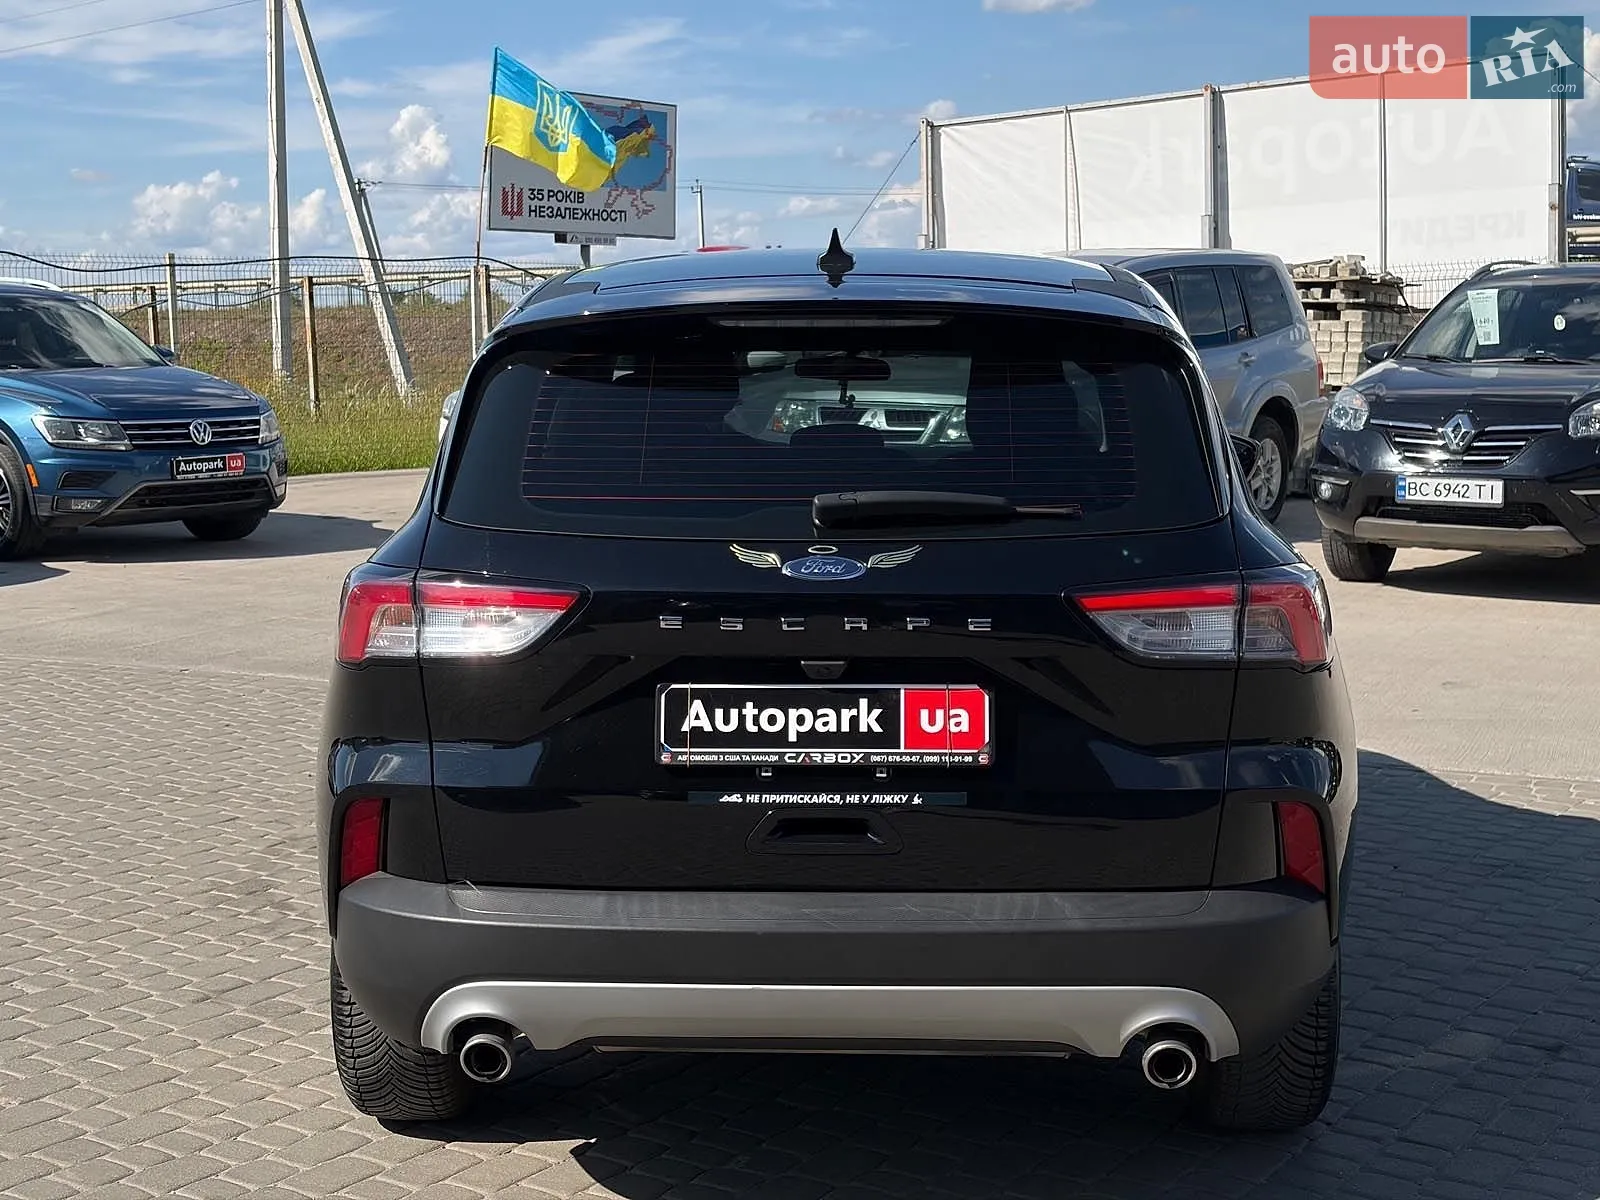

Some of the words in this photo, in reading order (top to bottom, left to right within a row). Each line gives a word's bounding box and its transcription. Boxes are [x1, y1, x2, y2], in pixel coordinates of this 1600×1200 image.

[528, 188, 544, 202] 35
[547, 189, 585, 204] РОКІВ
[528, 204, 627, 223] НЕЗАЛЕЖНОСТІ
[179, 458, 224, 472] Autopark
[230, 459, 242, 468] ua
[1408, 481, 1430, 497] BC
[1433, 482, 1470, 499] 6942
[800, 558, 847, 574] Ford
[659, 615, 992, 631] ESCAPE
[680, 698, 883, 742] Autopark
[919, 706, 971, 734] ua
[784, 752, 865, 765] CARBOX
[746, 794, 761, 804] НЕ
[762, 793, 844, 805] ПРИТИСКАЙСЯ,
[846, 794, 861, 804] НЕ
[861, 794, 870, 804] У
[870, 794, 909, 804] ЛІЖКУ
